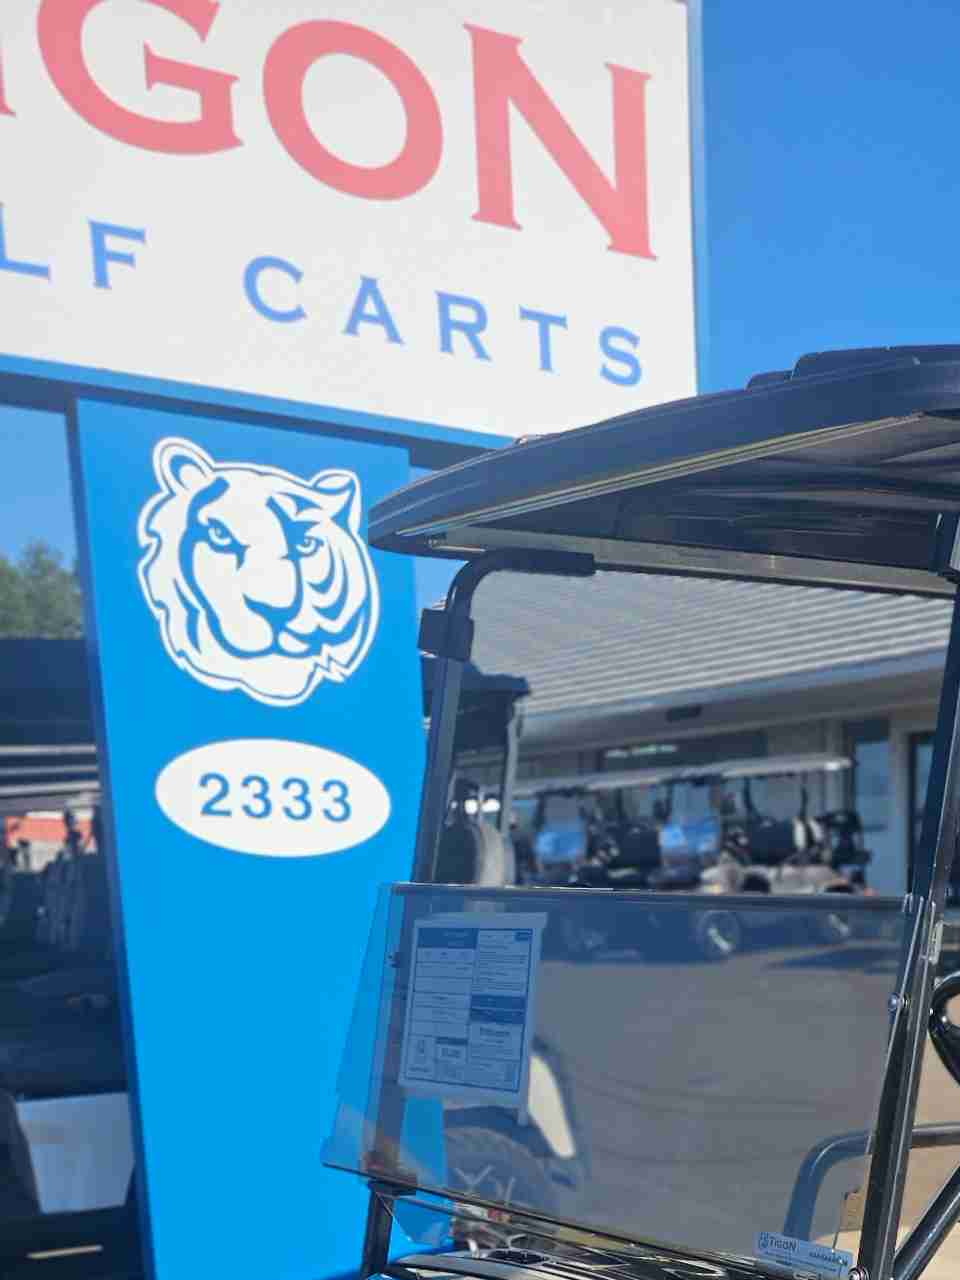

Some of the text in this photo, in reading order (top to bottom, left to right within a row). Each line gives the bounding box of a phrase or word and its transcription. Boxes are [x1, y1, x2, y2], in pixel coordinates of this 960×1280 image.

[0, 0, 657, 261] GON
[243, 256, 643, 387] CARTS
[199, 771, 352, 823] 2333
